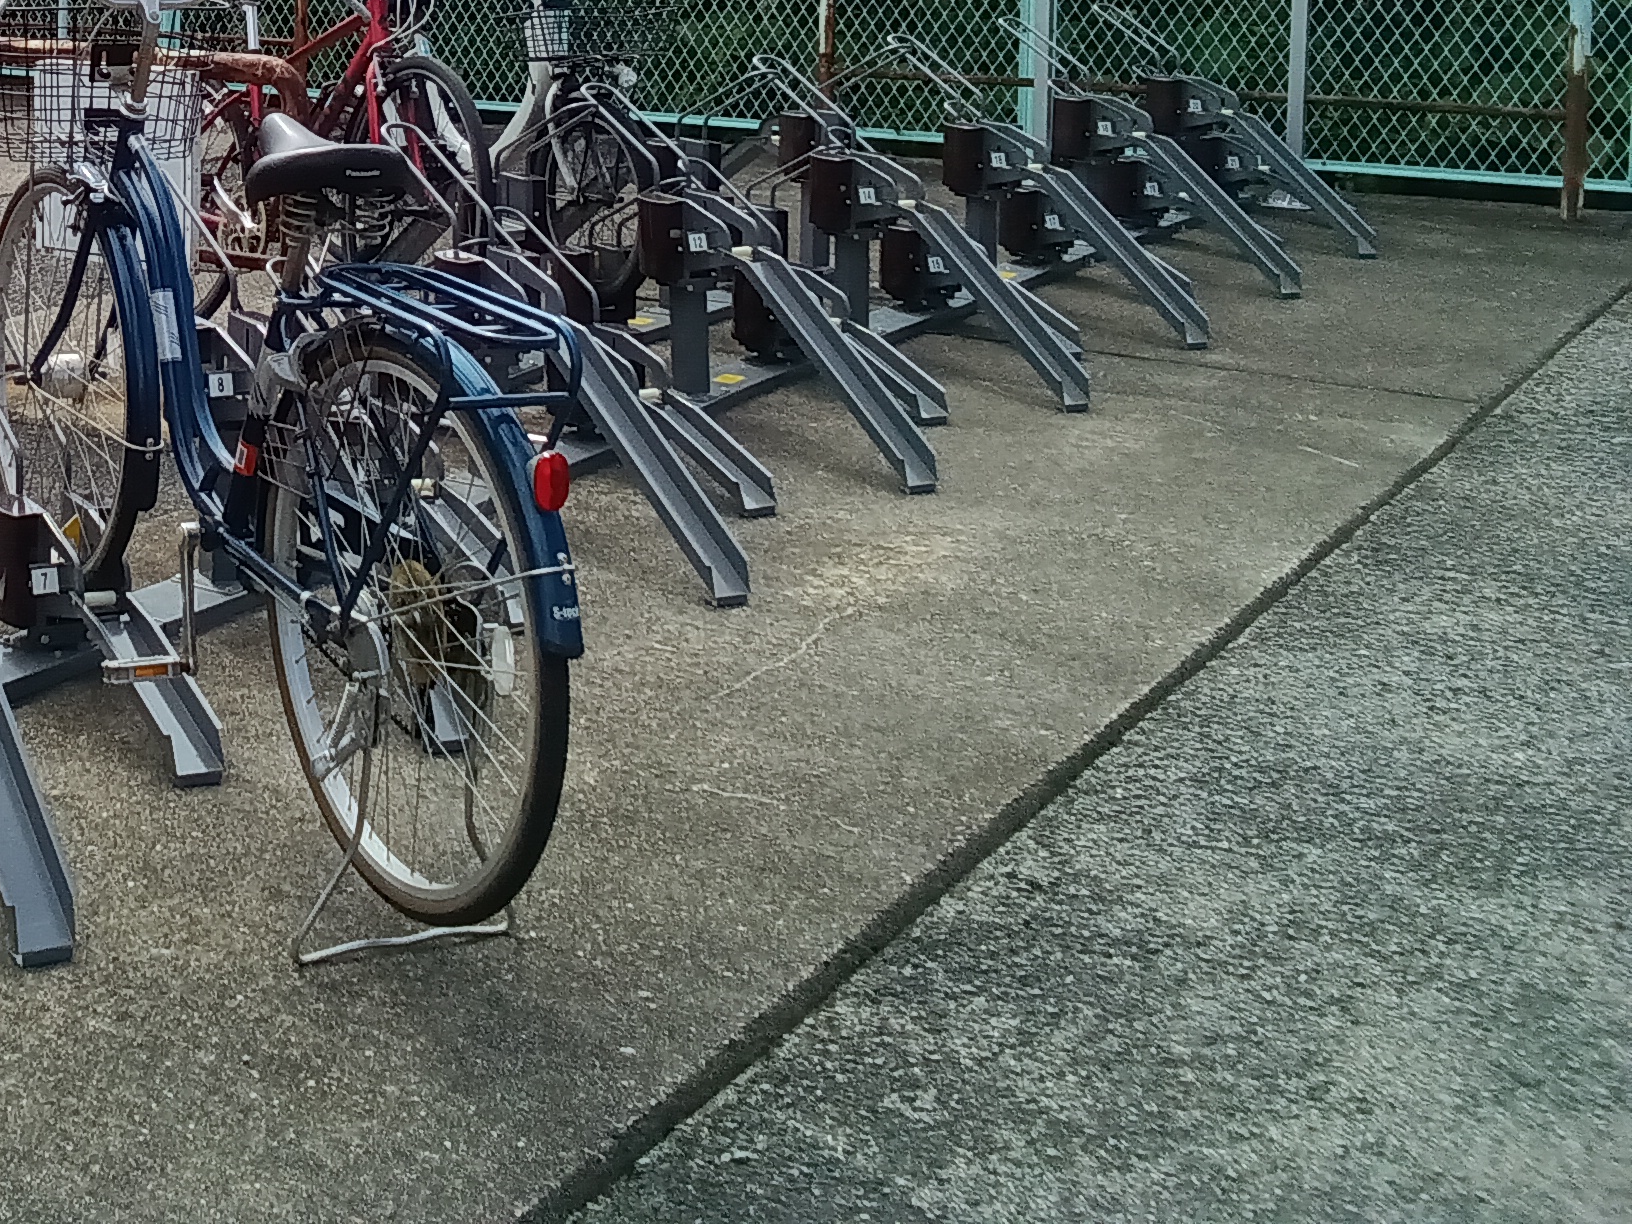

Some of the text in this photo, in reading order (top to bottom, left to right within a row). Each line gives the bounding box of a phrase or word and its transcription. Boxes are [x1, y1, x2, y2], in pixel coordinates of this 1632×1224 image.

[693, 235, 704, 249] 12
[217, 376, 225, 393] 8
[40, 571, 48, 591] 7
